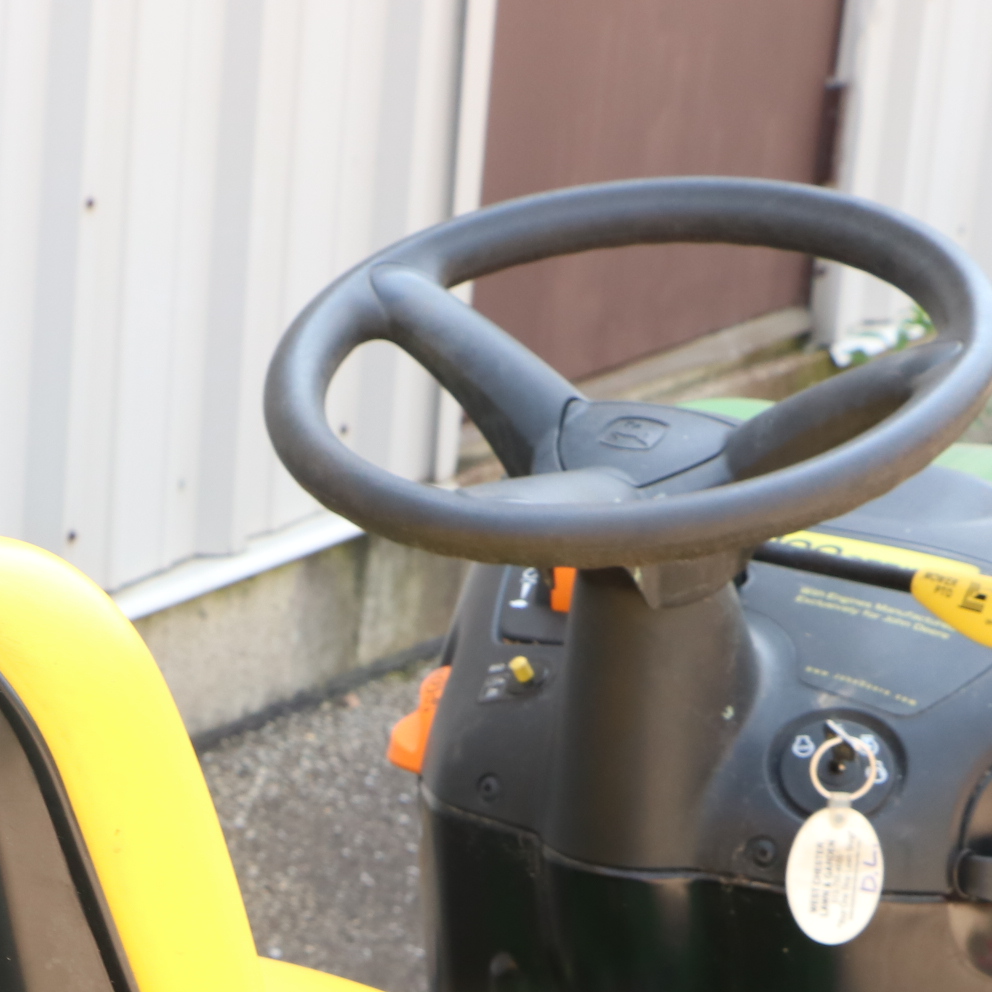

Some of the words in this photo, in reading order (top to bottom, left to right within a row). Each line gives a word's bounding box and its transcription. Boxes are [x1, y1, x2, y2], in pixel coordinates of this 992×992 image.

[924, 571, 959, 587] MOWER
[934, 584, 954, 598] PTO
[826, 591, 872, 609] Engines
[795, 594, 859, 616] Exclusively
[862, 609, 881, 620] for
[882, 614, 912, 628] John
[912, 621, 950, 641] Deere
[812, 841, 824, 885] CHESTER
[824, 839, 836, 880] GARDEN
[819, 890, 830, 917] LAWN
